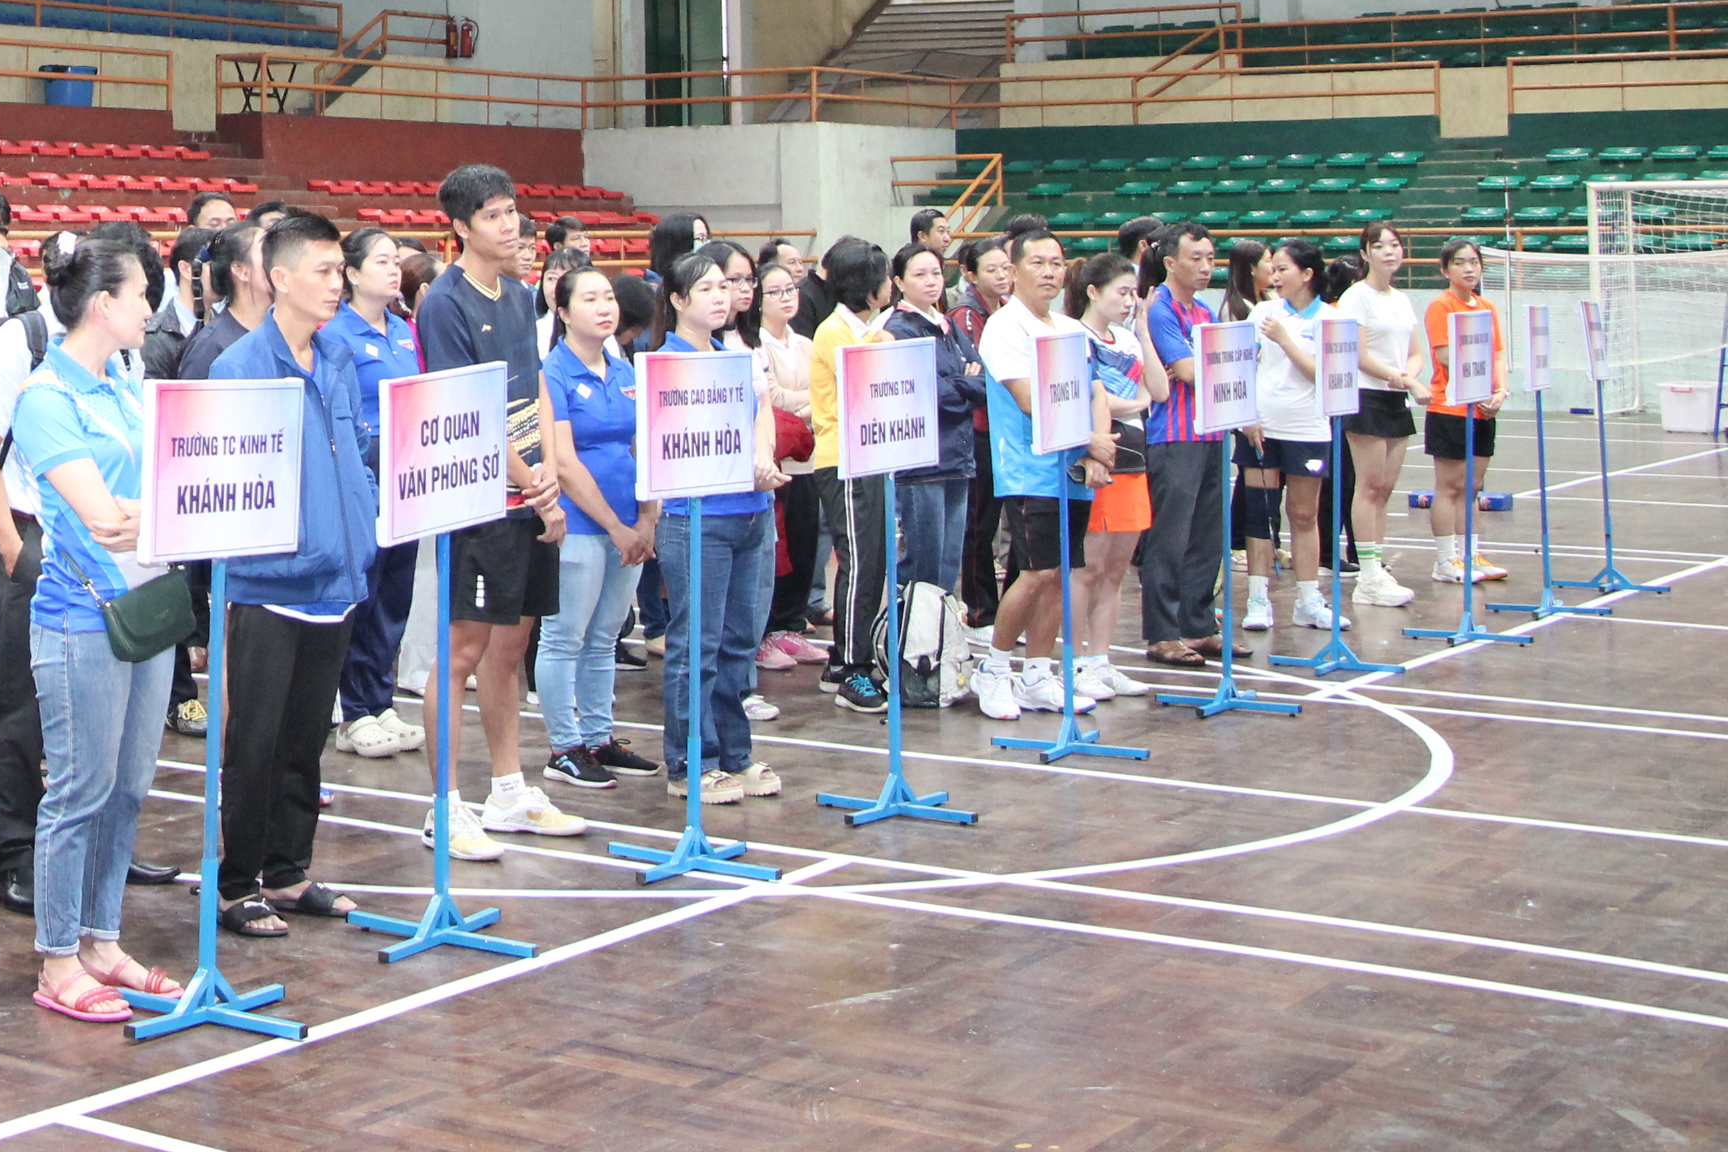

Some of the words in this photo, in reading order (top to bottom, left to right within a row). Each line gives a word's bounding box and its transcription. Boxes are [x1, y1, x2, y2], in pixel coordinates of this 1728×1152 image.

[659, 385, 689, 408] TRƯỜNG
[690, 388, 705, 406] CAO
[729, 387, 734, 403] Y
[735, 381, 745, 403] TẾ
[869, 378, 899, 399] TRƯỜNG
[900, 379, 915, 395] TCN
[1213, 382, 1231, 404] NINH
[171, 431, 218, 458] TRƯỜNG
[222, 435, 236, 455] TC
[240, 433, 268, 455] KINH
[271, 426, 285, 453] TẾ
[420, 415, 440, 448] CƠ
[444, 410, 480, 441] QUAN
[662, 426, 710, 461] KHÁNH
[715, 422, 742, 456] HÒA
[860, 417, 886, 446] DIÊN
[889, 413, 926, 442] KHÁNH
[398, 466, 427, 501] VĂN
[431, 455, 479, 492] PHÒNG
[482, 445, 500, 480] SỞ
[177, 477, 237, 515] KHÁNH
[242, 473, 276, 510] HÒA
